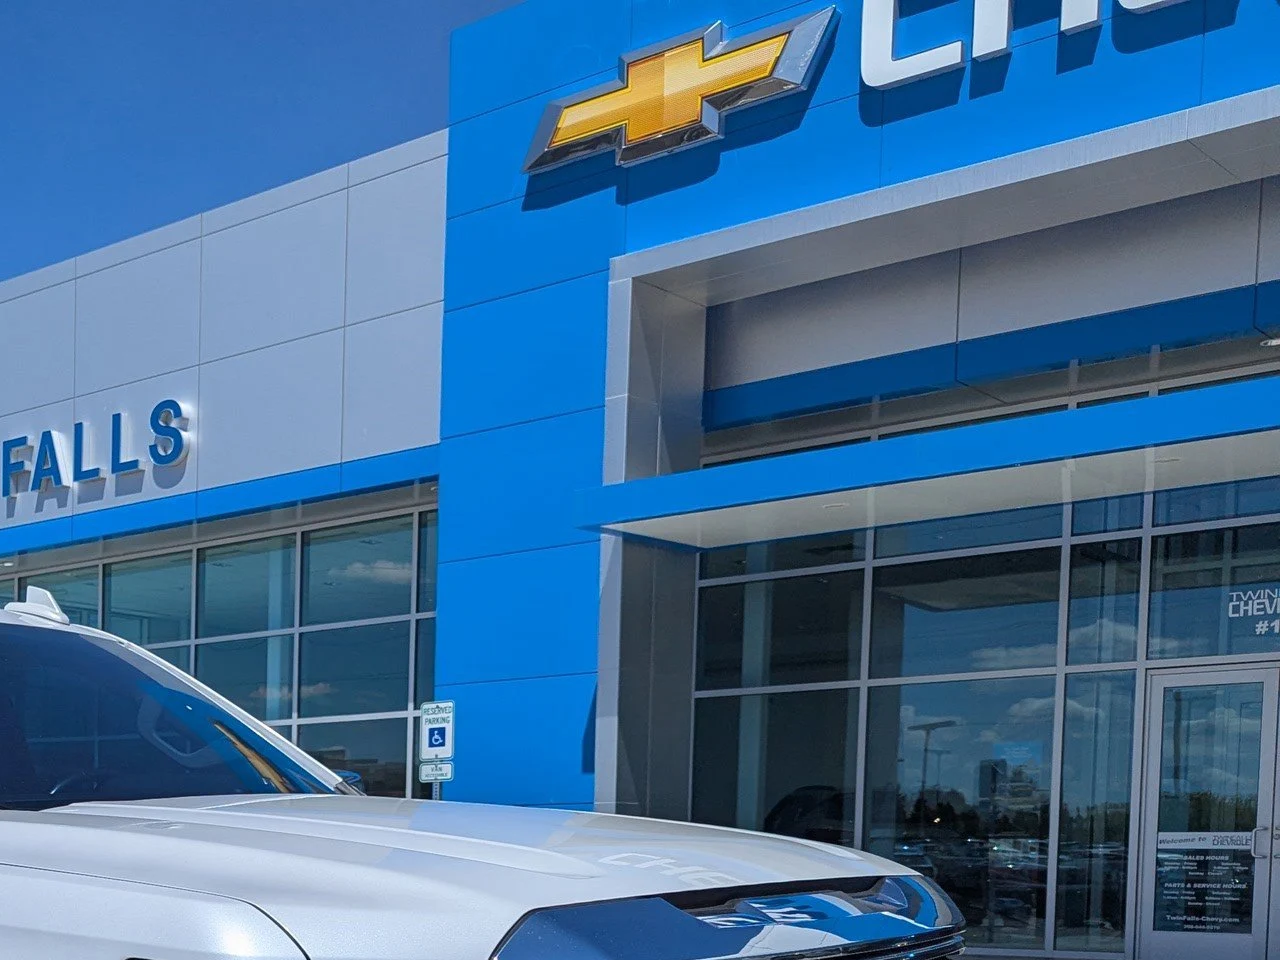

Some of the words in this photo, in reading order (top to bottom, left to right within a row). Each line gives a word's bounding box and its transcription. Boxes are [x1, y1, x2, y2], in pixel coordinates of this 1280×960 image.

[2, 399, 188, 498] FALLS
[1229, 588, 1280, 602] TWIN
[1228, 598, 1280, 618] CHEV
[424, 706, 452, 716] RESERVED
[424, 716, 451, 726] PARKING
